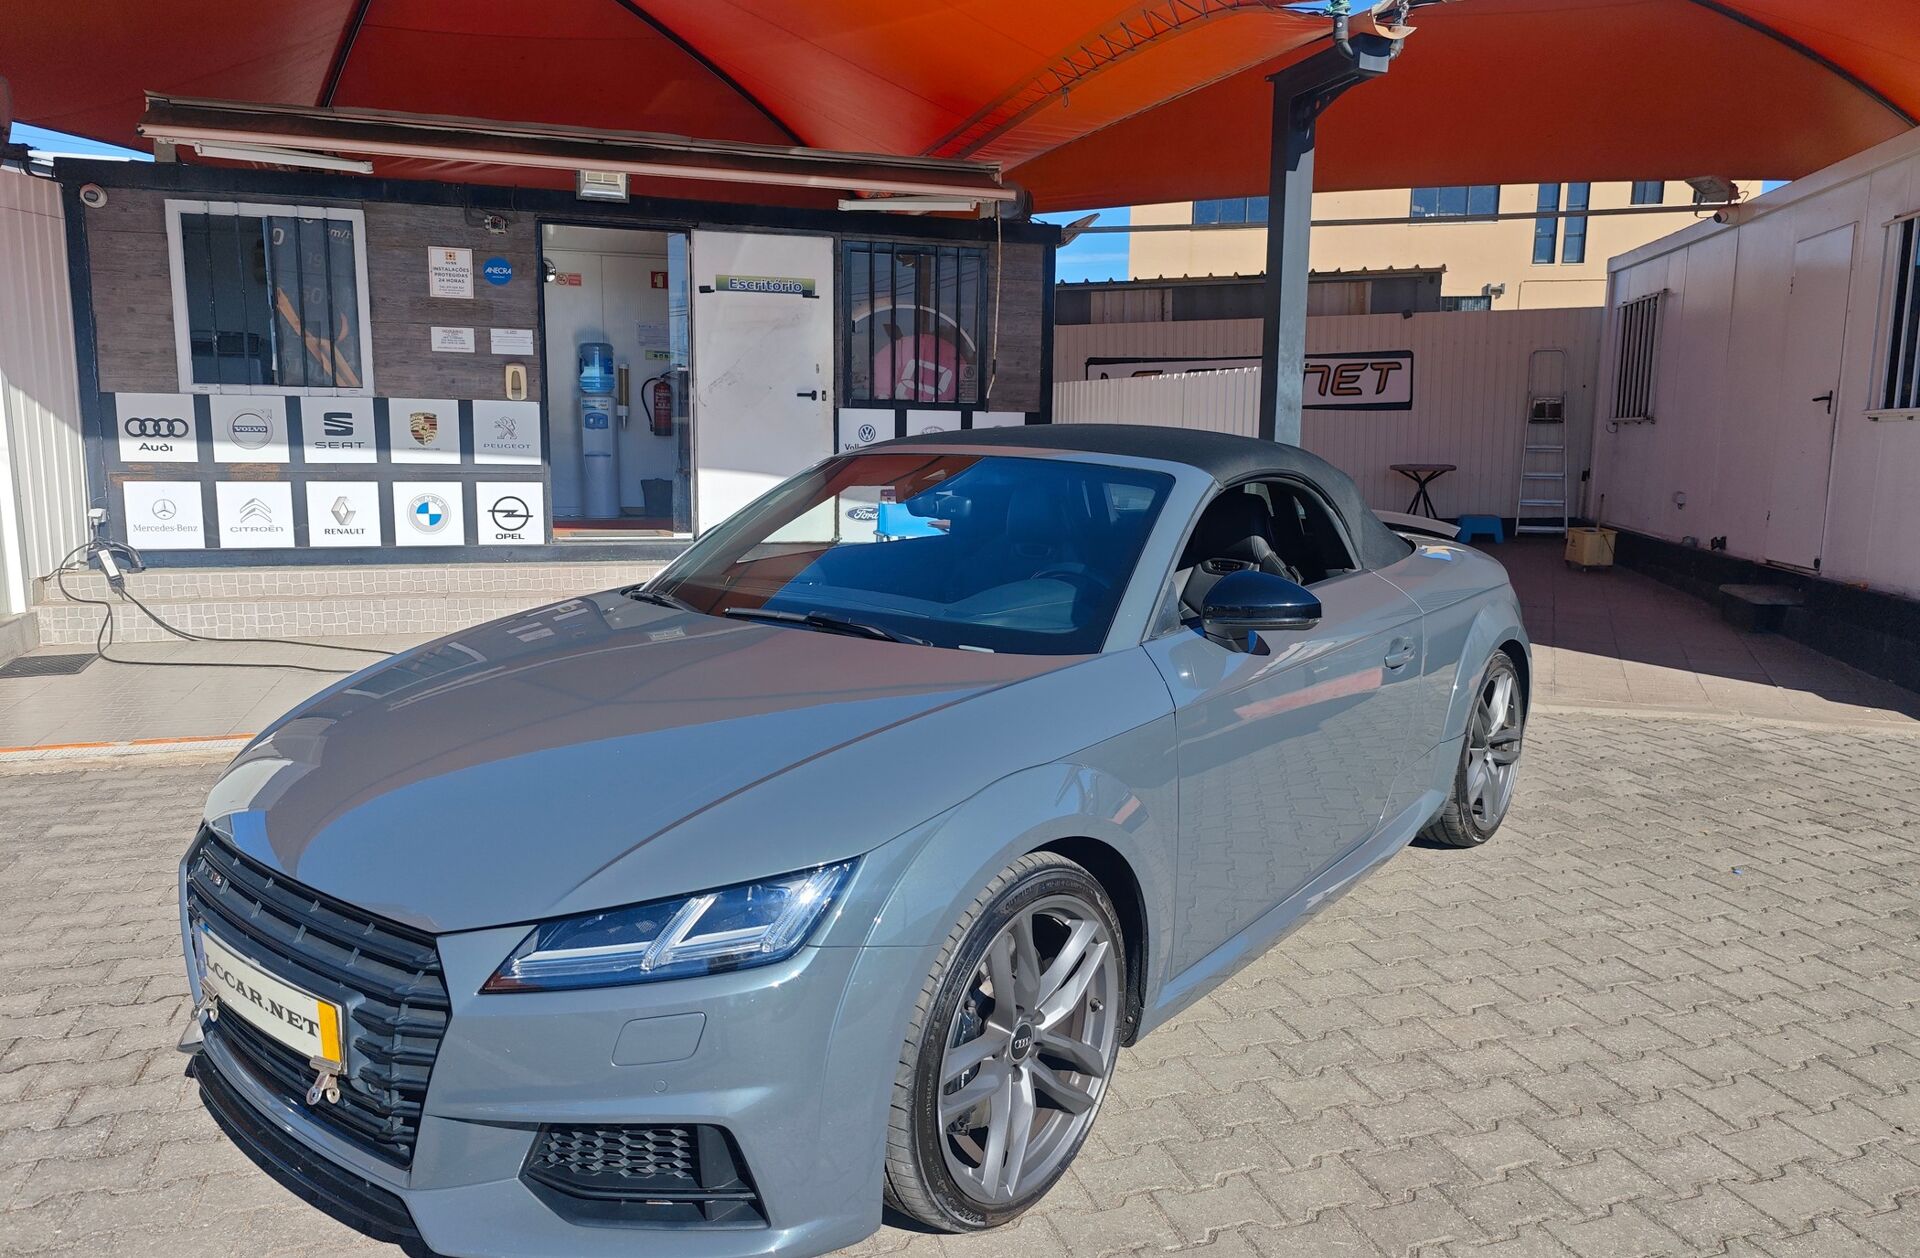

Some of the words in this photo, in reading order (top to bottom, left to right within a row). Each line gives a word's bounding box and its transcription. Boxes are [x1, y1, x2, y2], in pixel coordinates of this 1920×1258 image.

[485, 266, 512, 275] ANECRA
[729, 277, 803, 292] Escritório
[139, 442, 173, 452] Audi
[854, 508, 878, 520] Ford
[133, 524, 198, 533] Mercedes-Benz
[230, 524, 284, 532] CITROËN
[205, 953, 320, 1038] LCCAR.NET
